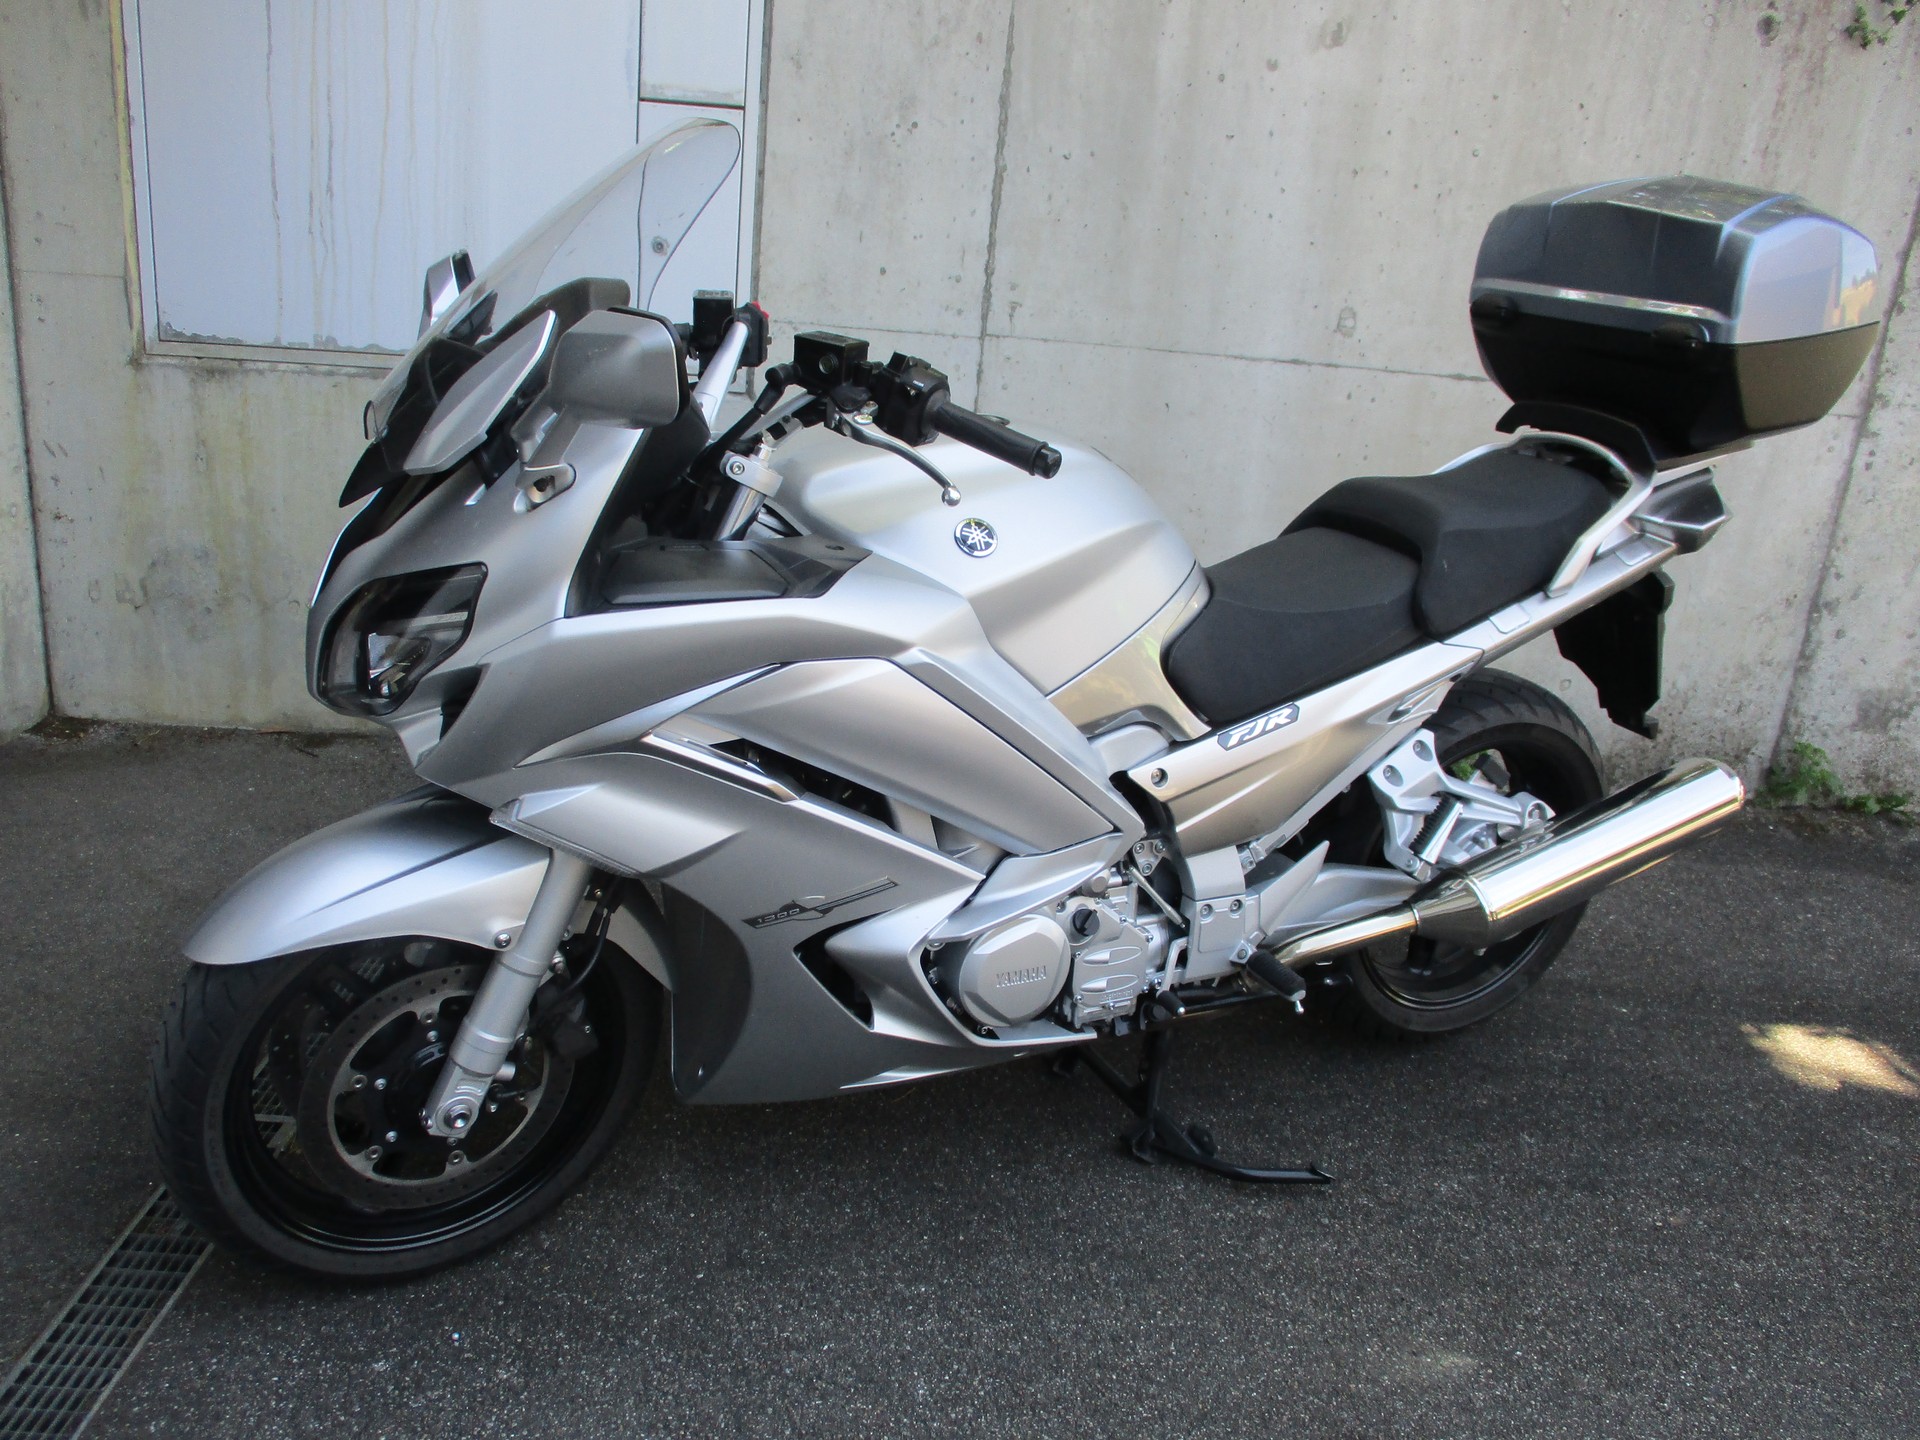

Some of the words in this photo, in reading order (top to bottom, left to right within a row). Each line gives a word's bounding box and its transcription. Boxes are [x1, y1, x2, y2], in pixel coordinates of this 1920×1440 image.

[1227, 707, 1293, 748] FJR
[757, 908, 800, 923] 1300
[996, 965, 1047, 988] YAMAHA
